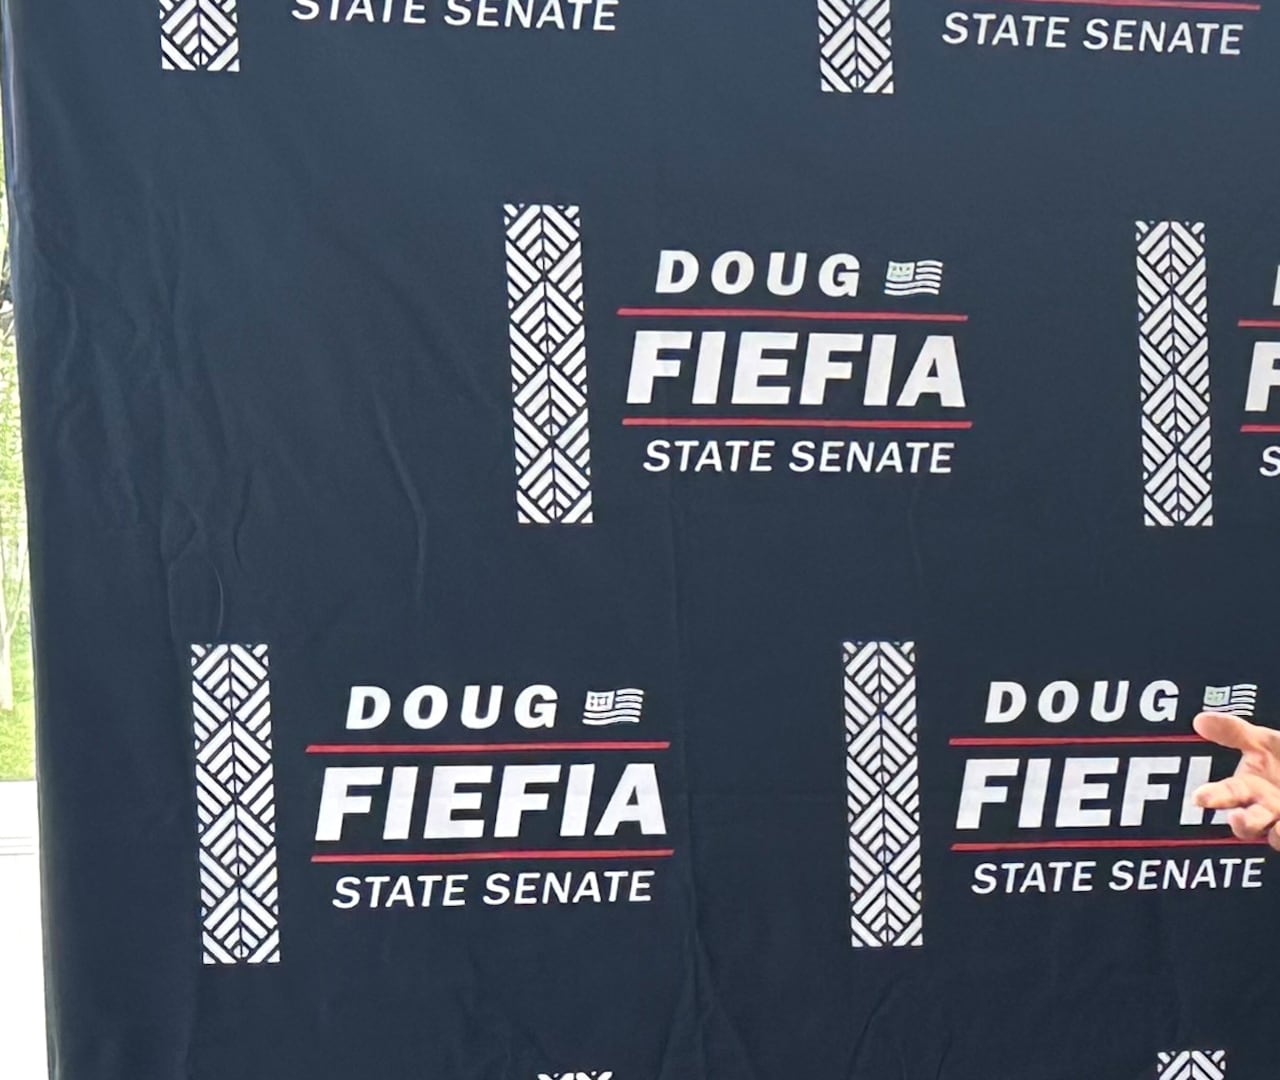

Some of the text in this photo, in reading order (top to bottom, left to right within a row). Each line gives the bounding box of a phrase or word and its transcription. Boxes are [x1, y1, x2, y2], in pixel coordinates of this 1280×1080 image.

[291, 0, 619, 31] STATE SENATE
[942, 11, 1244, 55] STATE SENATE
[655, 249, 860, 297] DOUG
[626, 330, 966, 408] FIEFIA
[643, 439, 955, 474] STATE SENATE
[345, 684, 558, 730] DOUG
[984, 679, 1179, 724] DOUG
[314, 763, 667, 841] FIEFIA
[955, 756, 1229, 829] FIEFI
[332, 870, 655, 909] STATE SENATE
[971, 857, 1265, 894] STATE SENATE
